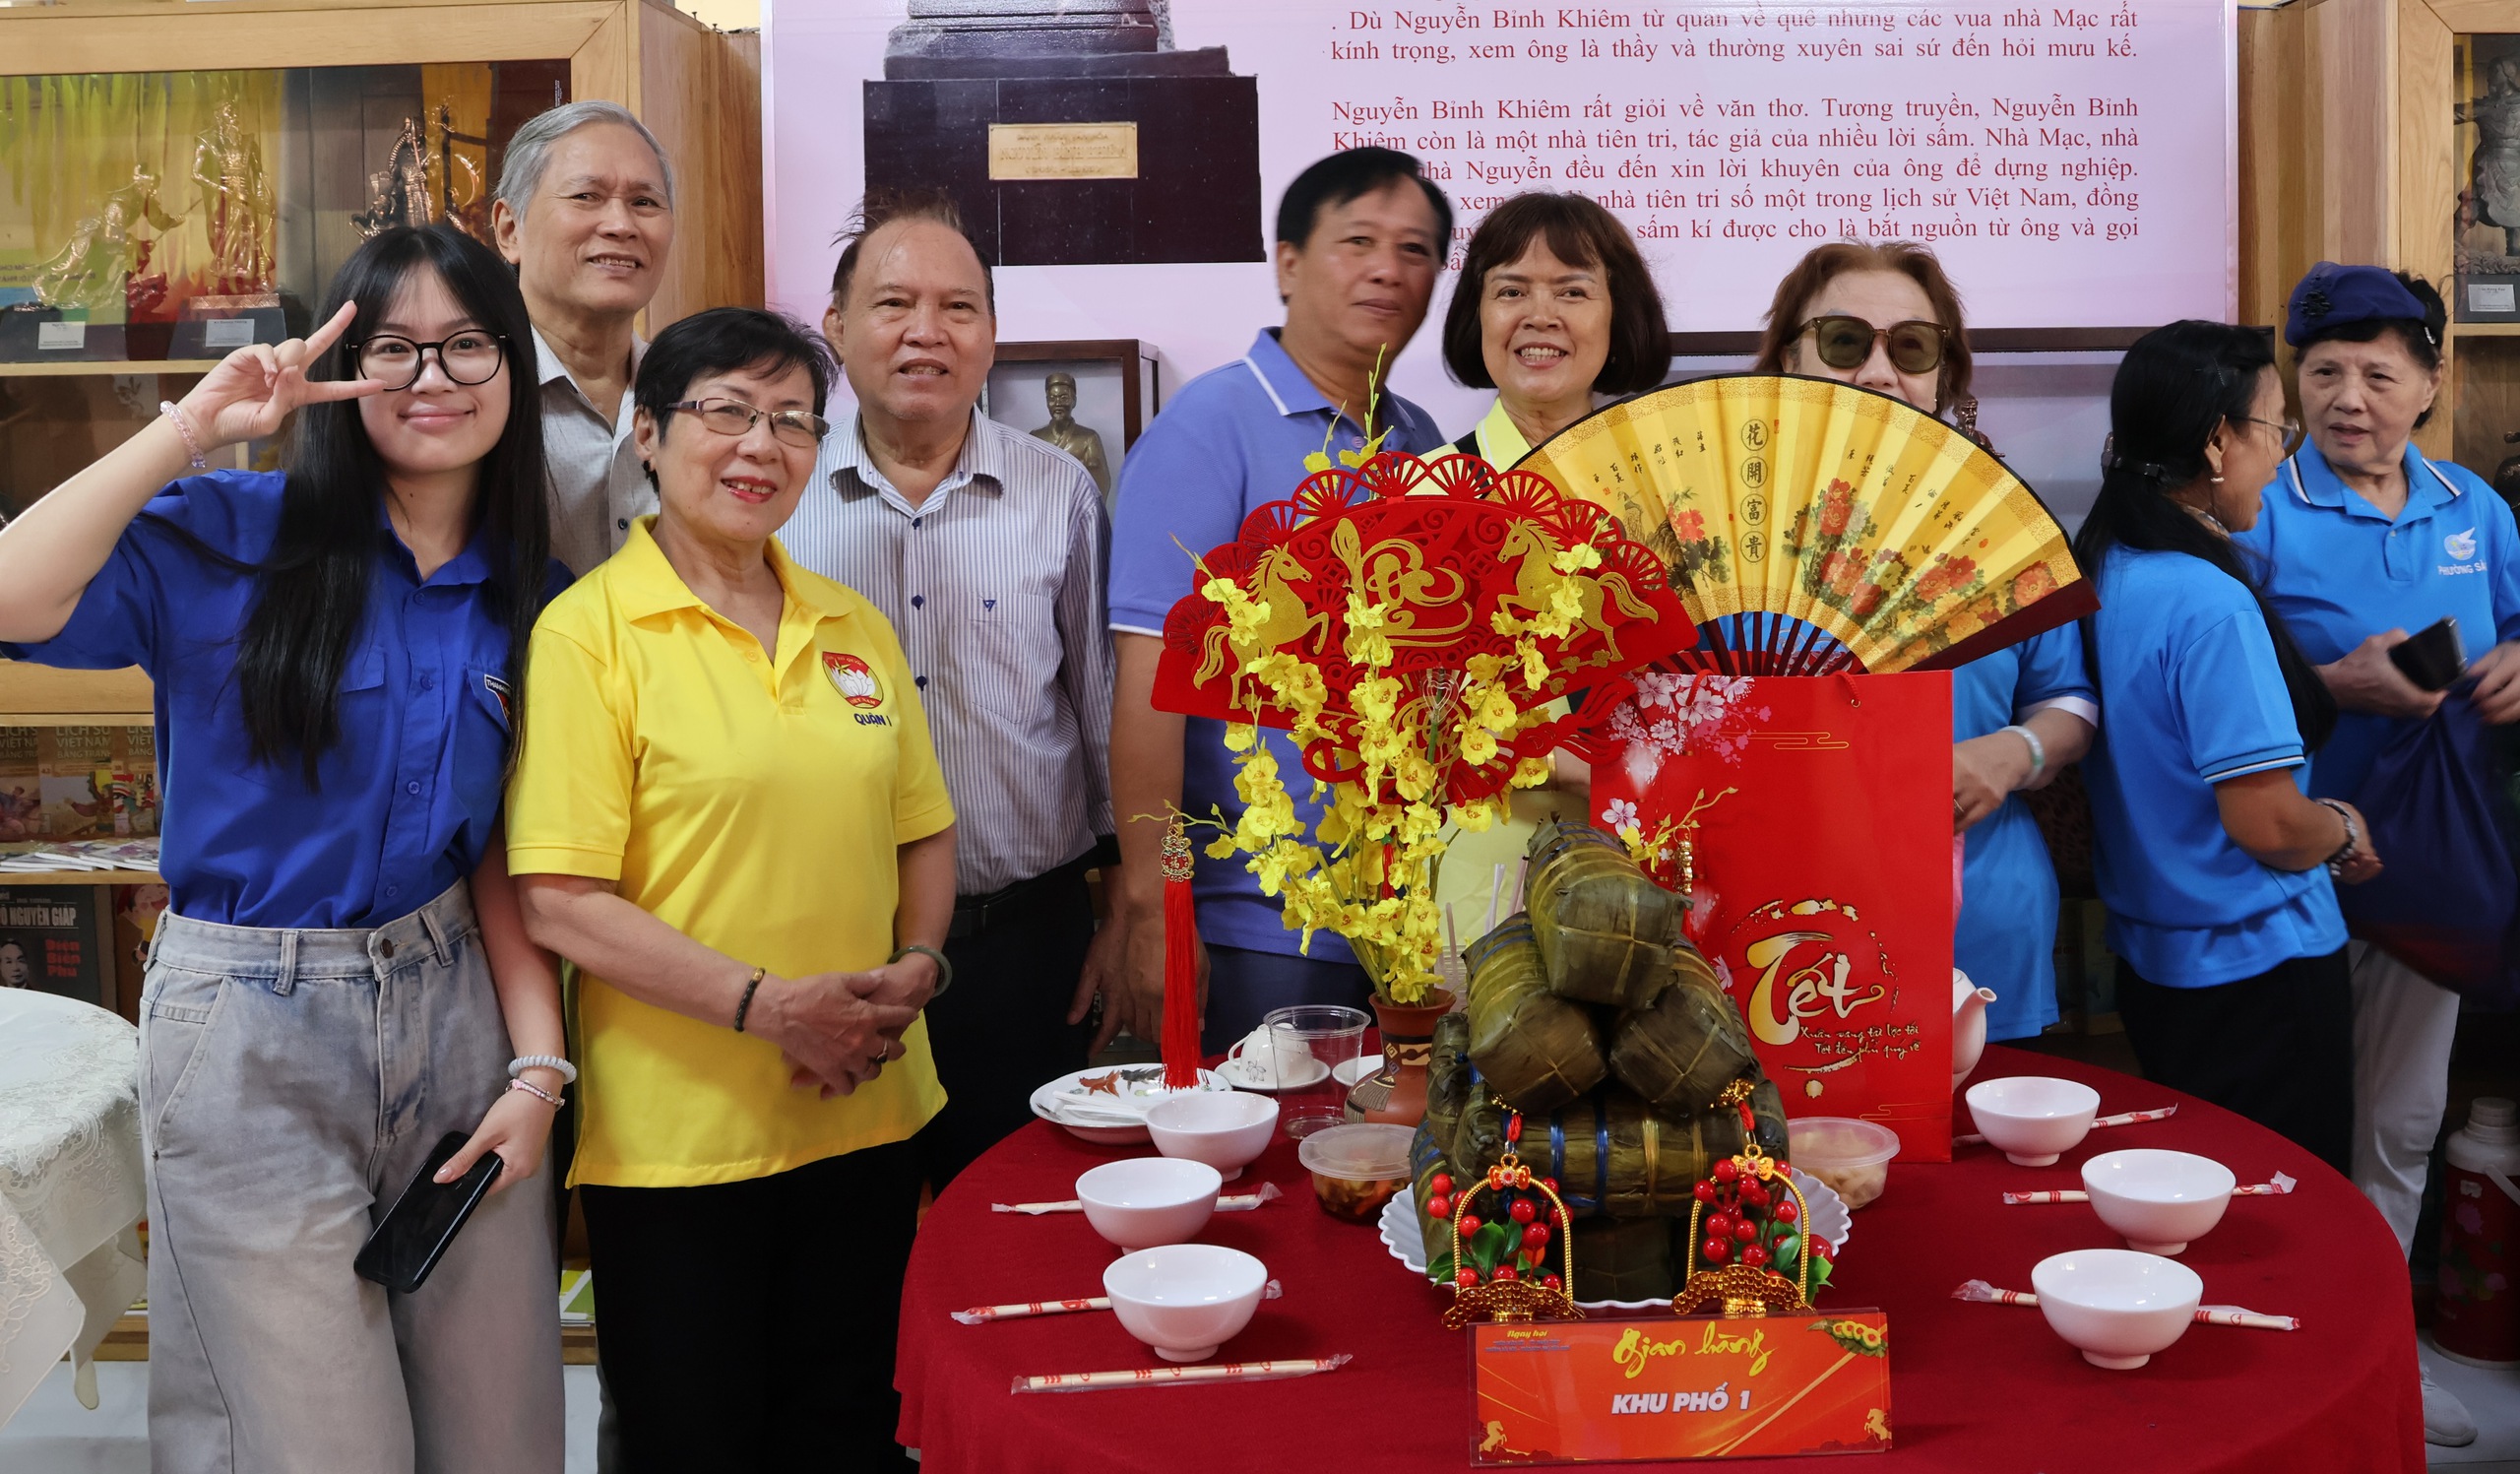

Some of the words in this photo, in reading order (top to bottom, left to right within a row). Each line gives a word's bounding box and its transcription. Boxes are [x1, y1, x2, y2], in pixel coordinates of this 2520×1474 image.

[1350, 11, 1382, 30] Dù
[1394, 3, 1480, 33] Nguyễn
[1493, 9, 1544, 28] Bỉnh
[1557, 9, 1630, 28] Khiêm
[1643, 9, 1665, 28] từ
[1676, 13, 1729, 32] quan
[1908, 9, 1941, 27] các
[1954, 14, 1991, 28] vua
[2004, 9, 2041, 27] nhà
[2053, 9, 2099, 31] Mạc
[2110, 1, 2137, 27] rất
[1331, 40, 1379, 59] kính
[1392, 43, 1456, 64] trọng,
[1469, 45, 1515, 58] xem
[1528, 39, 1568, 63] ông
[1581, 38, 1600, 57] là
[1611, 33, 1658, 62] thầy
[1670, 38, 1696, 57] và
[1709, 38, 1785, 62] thường
[1797, 38, 1862, 61] xuyên
[1875, 37, 1903, 56] sai
[1917, 38, 1940, 56] sứ
[1952, 32, 1989, 56] đến
[2002, 37, 2035, 56] hỏi
[2048, 43, 2095, 56] mưu
[2108, 33, 2136, 56] kế.
[1332, 96, 1418, 125] Nguyễn
[1432, 100, 1484, 119] Bỉnh
[1497, 99, 1570, 118] Khiêm
[1584, 94, 1611, 117] rất
[1625, 98, 1666, 123] giỏi
[1679, 94, 1704, 117] về
[1717, 99, 1755, 117] văn
[1768, 98, 1808, 116] thơ.
[1822, 98, 1893, 122] Tương
[1906, 93, 1979, 122] truyền,
[1992, 94, 2075, 121] Nguyễn
[2089, 97, 2138, 116] Bỉnh
[1333, 131, 1406, 150] Khiêm
[1418, 131, 1456, 150] còn
[1467, 130, 1485, 149] là
[1496, 130, 1538, 153] một
[1547, 130, 1587, 148] nhà
[1597, 129, 1637, 148] tiên
[1648, 129, 1676, 151] tri,
[1688, 129, 1718, 147] tác
[1730, 128, 1761, 153] giả
[1772, 129, 1808, 147] của
[1819, 123, 1877, 147] nhiều
[1888, 128, 1916, 147] lời
[1926, 122, 1978, 148] sấm.
[1984, 128, 2029, 146] Nhà
[2039, 128, 2091, 150] Mạc,
[2102, 128, 2139, 146] nhà
[1466, 156, 1551, 184] Nguyễn
[1566, 155, 1605, 178] đều
[1618, 154, 1657, 178] đến
[1670, 159, 1705, 177] xin
[1720, 159, 1750, 177] lời
[1761, 159, 1840, 182] khuyên
[1854, 159, 1890, 176] của
[1904, 159, 1943, 181] ông
[1957, 153, 1981, 176] để
[1994, 158, 2048, 181] dựng
[2061, 158, 2137, 182] nghiệp.
[1597, 190, 1636, 208] nhà
[1646, 189, 1686, 208] tiên
[1697, 189, 1720, 208] tri
[1732, 183, 1753, 208] số
[1764, 189, 1805, 211] một
[1816, 191, 1872, 212] trong
[1883, 188, 1922, 211] lịch
[1932, 188, 1959, 207] sử
[1966, 188, 2009, 210] Việt
[2020, 188, 2076, 210] Nam,
[2087, 182, 2139, 211] đồng
[1637, 215, 1679, 238] sấm
[1691, 220, 1711, 237] kí
[1723, 219, 1777, 241] được
[1789, 219, 1826, 237] cho
[1839, 219, 1858, 237] là
[1868, 213, 1900, 236] bắt
[1912, 213, 1977, 241] nguồn
[1988, 218, 2010, 236] từ
[2021, 218, 2059, 241] ông
[2071, 218, 2095, 235] và
[2107, 217, 2138, 241] gọi
[853, 712, 887, 728] QUẬN
[1746, 930, 1885, 1046] Tết
[1611, 1393, 1669, 1414] KHU
[1672, 1381, 1730, 1412] PHỐ
[1739, 1389, 1751, 1410] 1
